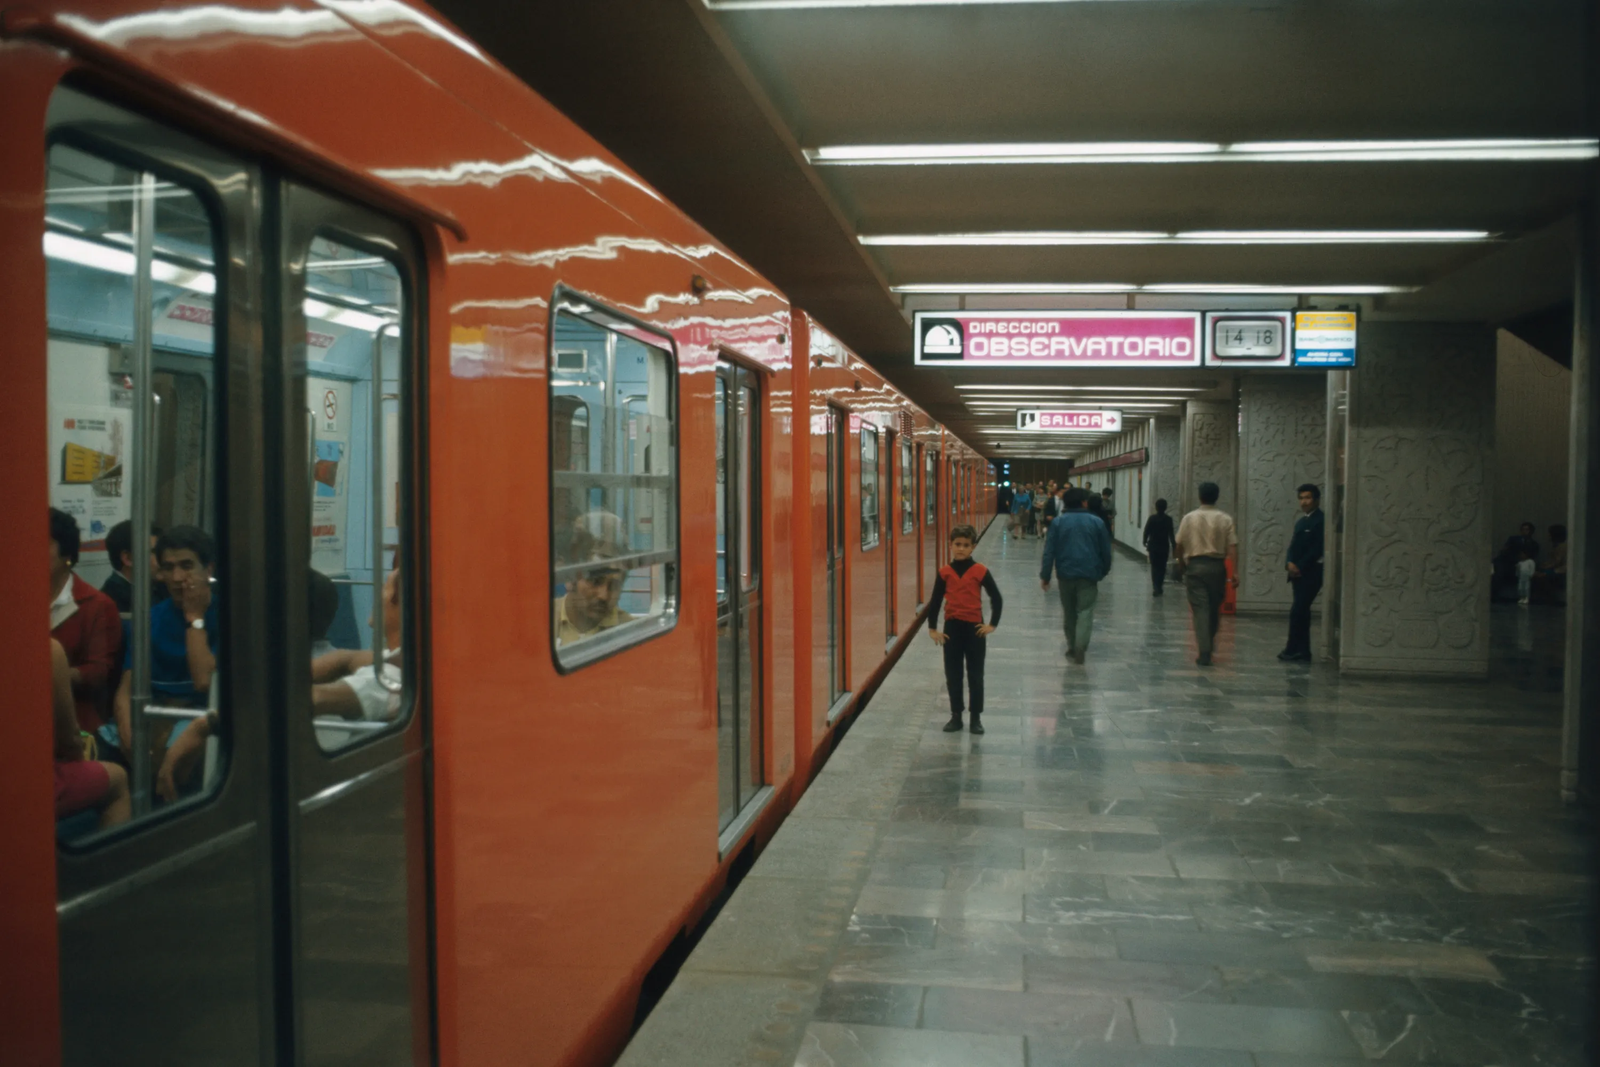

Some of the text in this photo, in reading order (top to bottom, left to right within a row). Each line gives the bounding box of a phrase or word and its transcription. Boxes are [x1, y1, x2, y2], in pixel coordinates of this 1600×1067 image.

[968, 321, 1060, 334] DIRECCION
[1225, 328, 1273, 345] 14 18
[969, 336, 1192, 357] OBSERVATORIO
[1040, 415, 1101, 426] SALIDA
